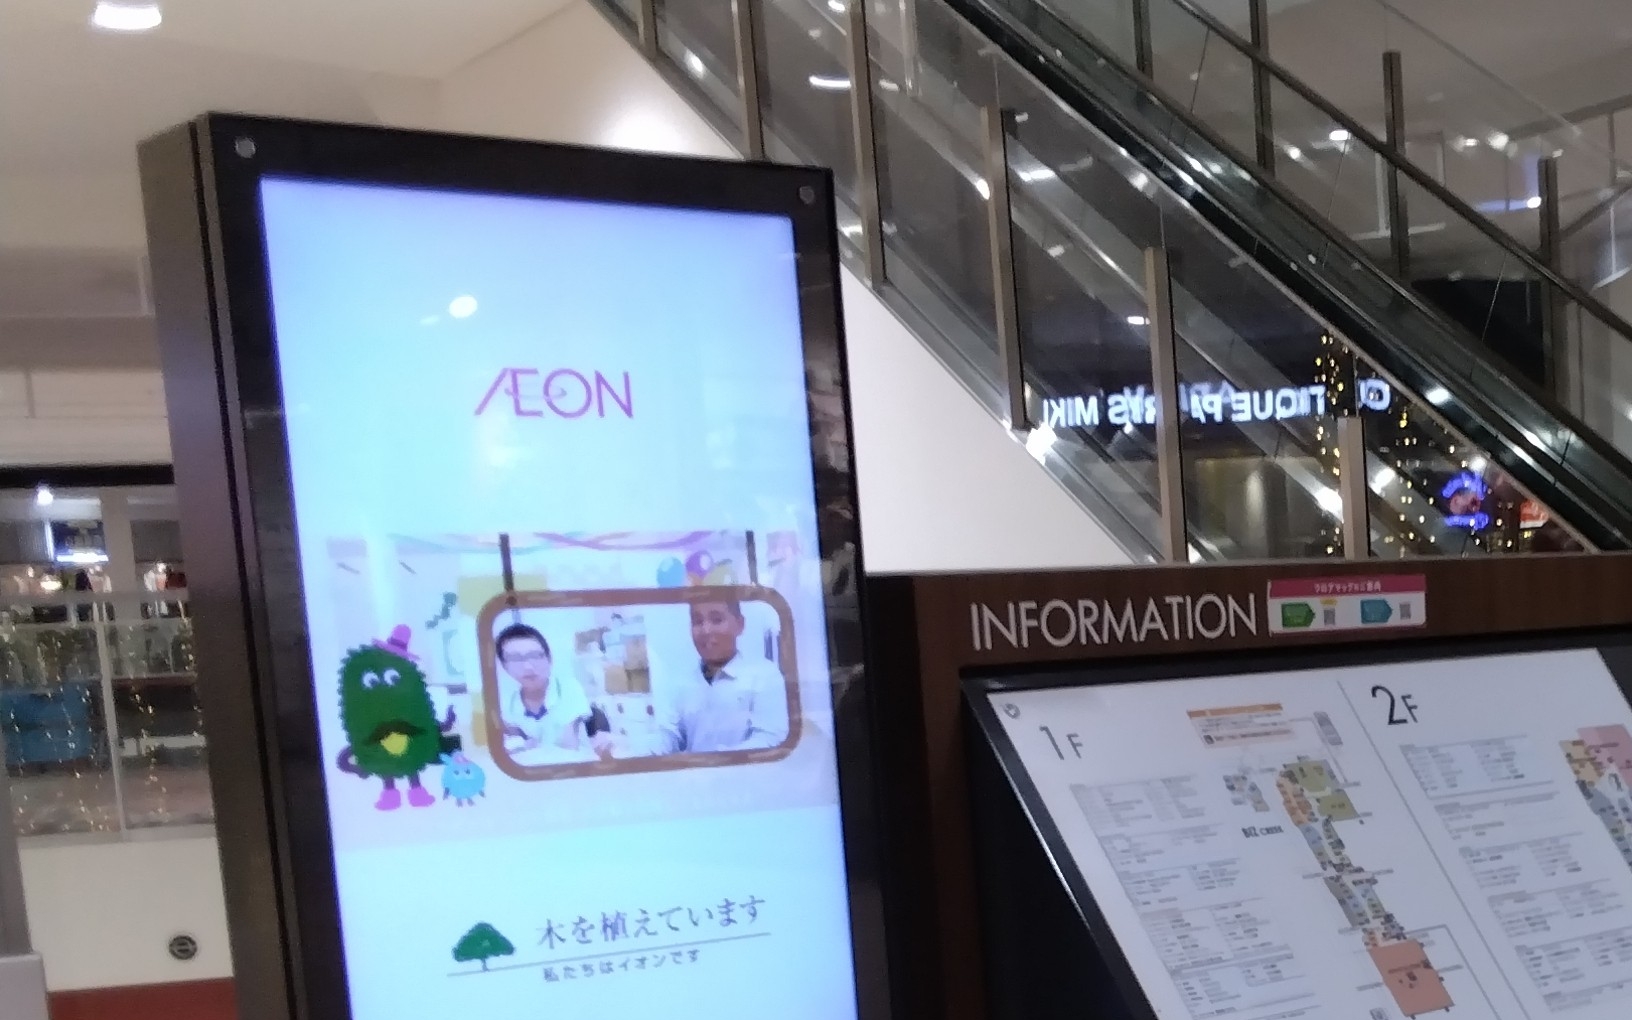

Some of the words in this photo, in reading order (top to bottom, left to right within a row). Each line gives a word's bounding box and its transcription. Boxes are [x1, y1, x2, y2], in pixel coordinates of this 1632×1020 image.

[970, 593, 1257, 651] INFORMATION
[1371, 684, 1419, 726] 2F
[1039, 725, 1084, 761] 1F
[537, 895, 766, 949] 木を植えています
[543, 949, 700, 982] 私たちはイオンです
